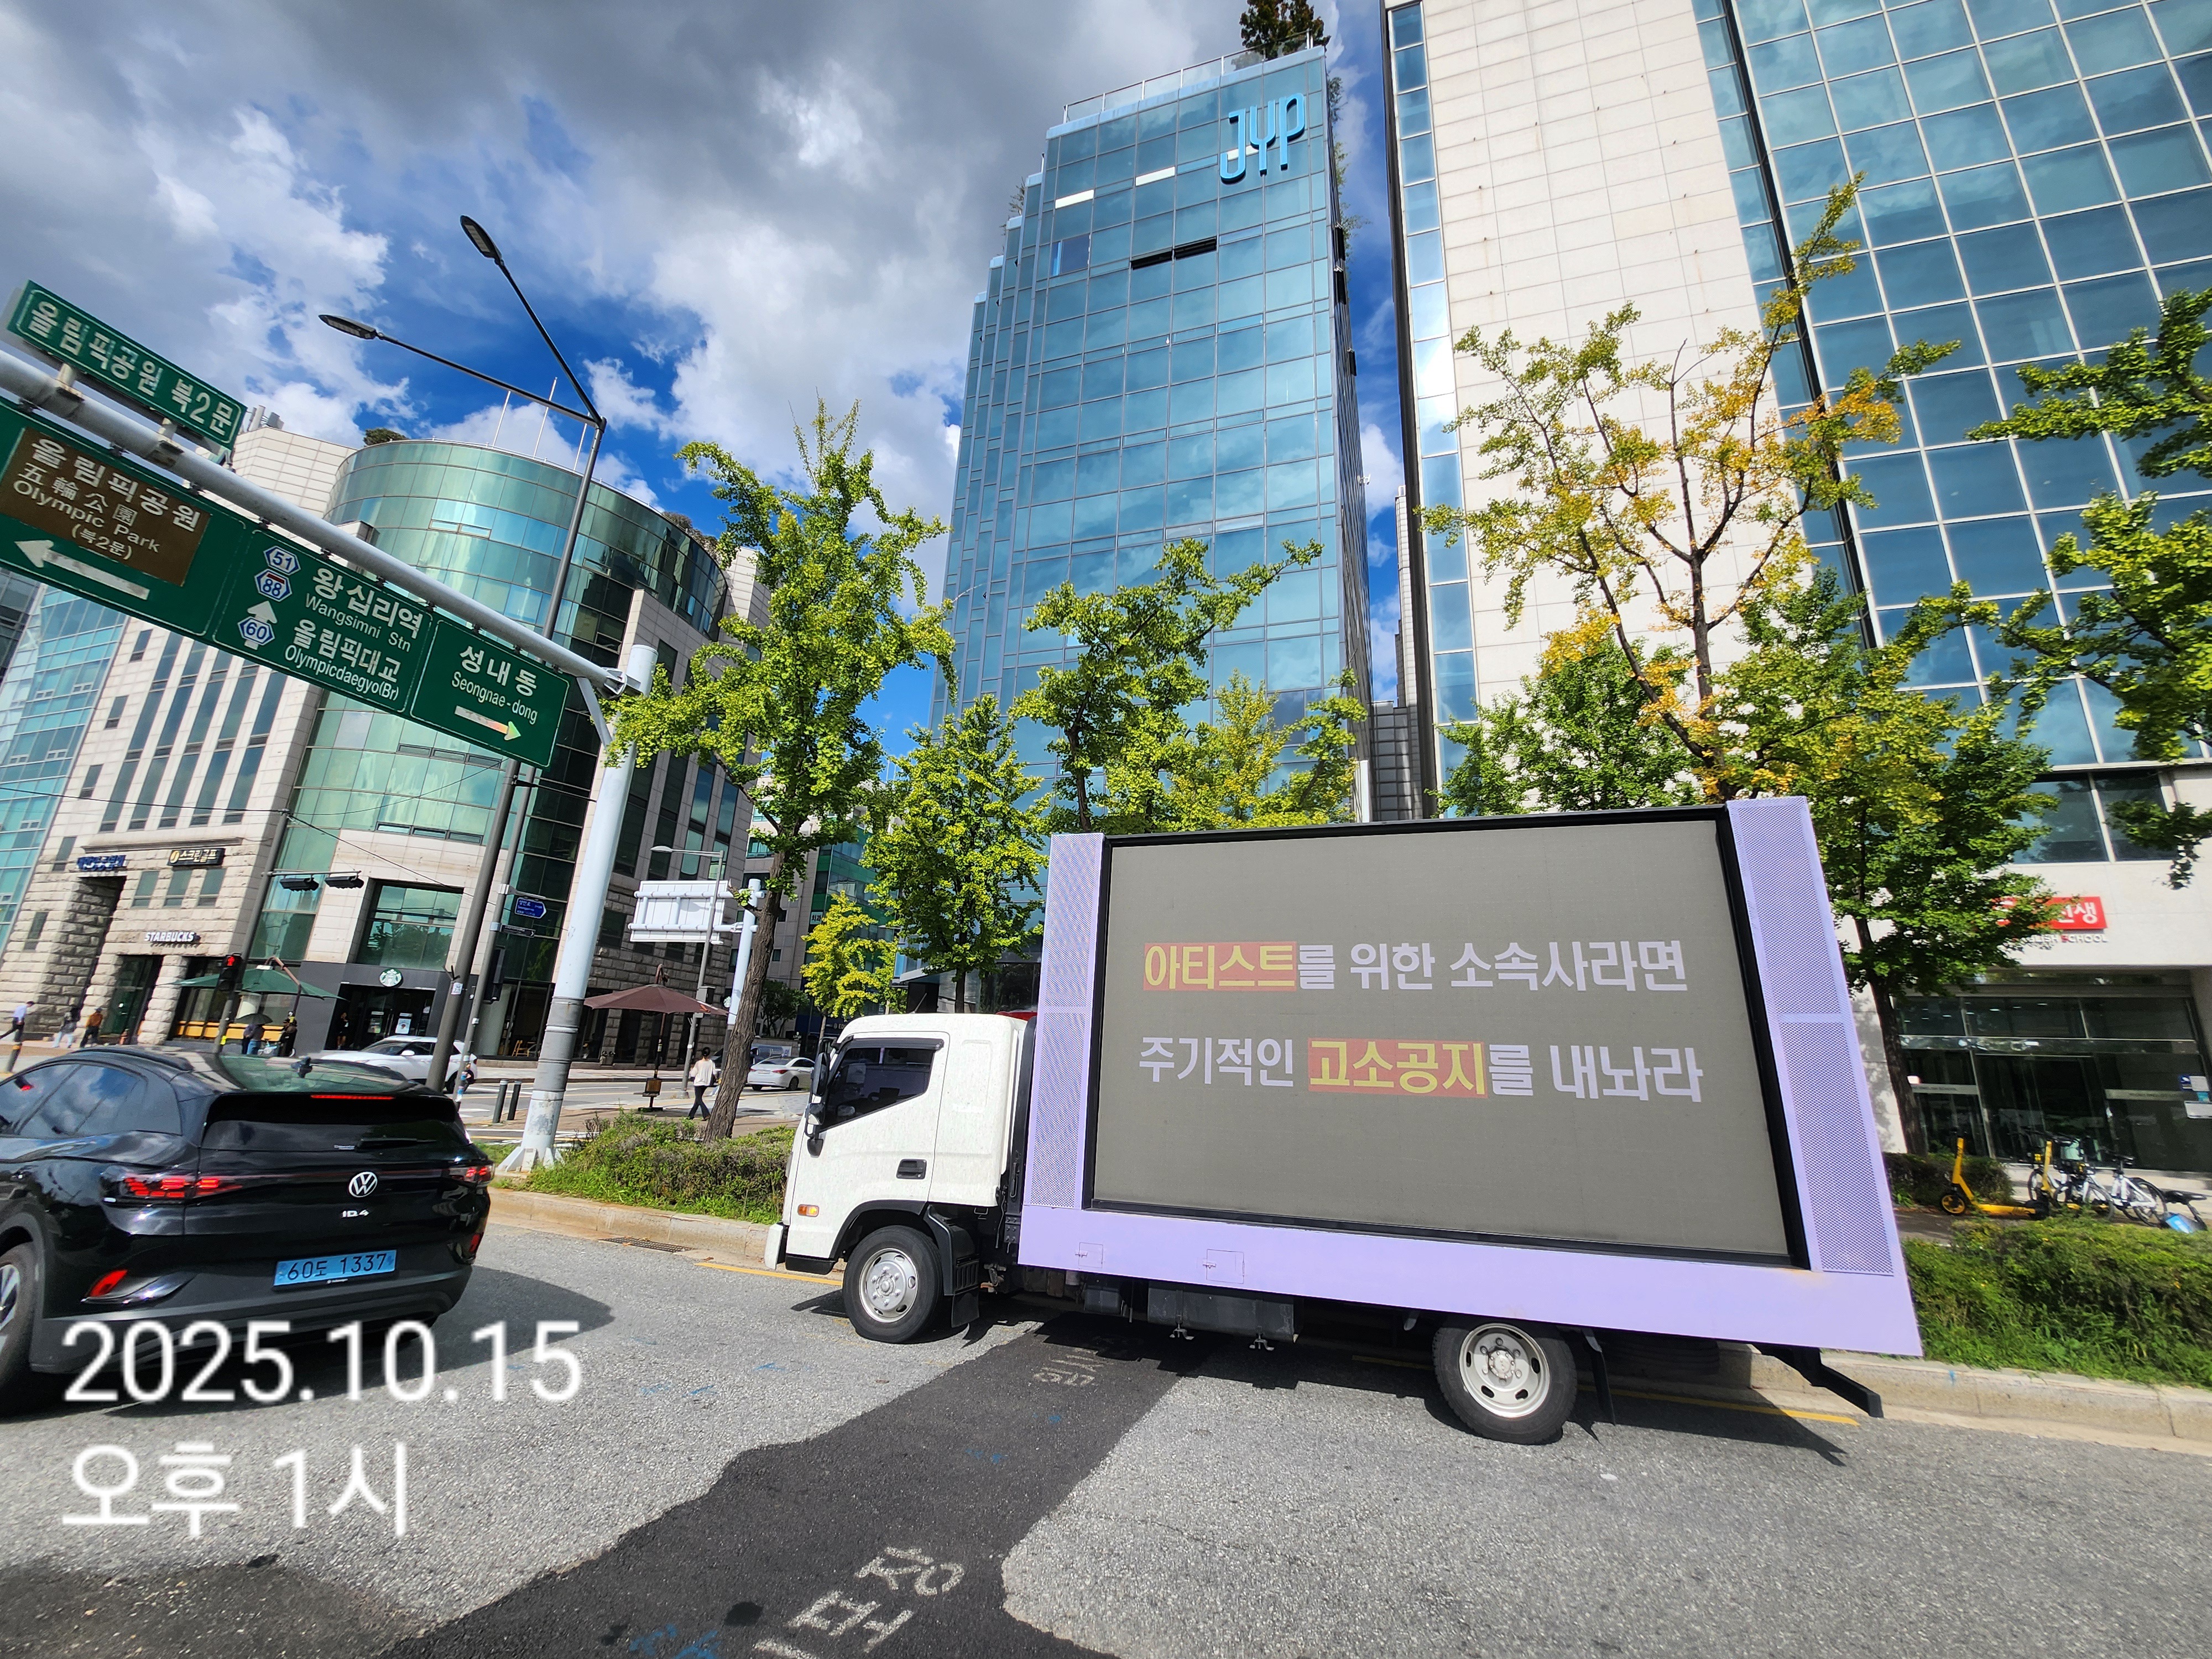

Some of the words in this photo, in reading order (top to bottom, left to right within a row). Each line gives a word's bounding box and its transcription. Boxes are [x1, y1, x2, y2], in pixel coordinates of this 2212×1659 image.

[1220, 93, 1305, 183] JYP
[28, 301, 163, 397] 올림픽공원
[170, 378, 233, 436] 북2문
[18, 462, 138, 526] 五輪公園
[32, 439, 201, 532] 올림픽공원
[13, 480, 105, 528] Olympic
[113, 524, 161, 553] Park
[72, 524, 132, 560] (북2문)
[263, 578, 282, 596] 88
[273, 551, 293, 570] 51
[247, 622, 267, 640] 60
[305, 593, 382, 639] Wangsimni
[388, 632, 411, 652] Stn
[313, 568, 423, 639] 왕십리역
[285, 645, 399, 701] Olympicdaegyo(Br)
[293, 619, 401, 682] 올림픽대교
[460, 646, 536, 696] 성내동
[144, 932, 195, 942] STARBUCKS
[2061, 934, 2108, 943] SCHOOL
[1144, 943, 1336, 990] 아티스트를
[1349, 942, 1436, 990] 위한
[1450, 940, 1688, 992] 소속사라면
[1139, 1036, 1295, 1087] 주기적인
[1310, 1040, 1534, 1097] 고소공지를
[1550, 1044, 1703, 1103] 내놔라
[287, 1261, 328, 1281] 60도
[340, 1254, 387, 1275] 1337
